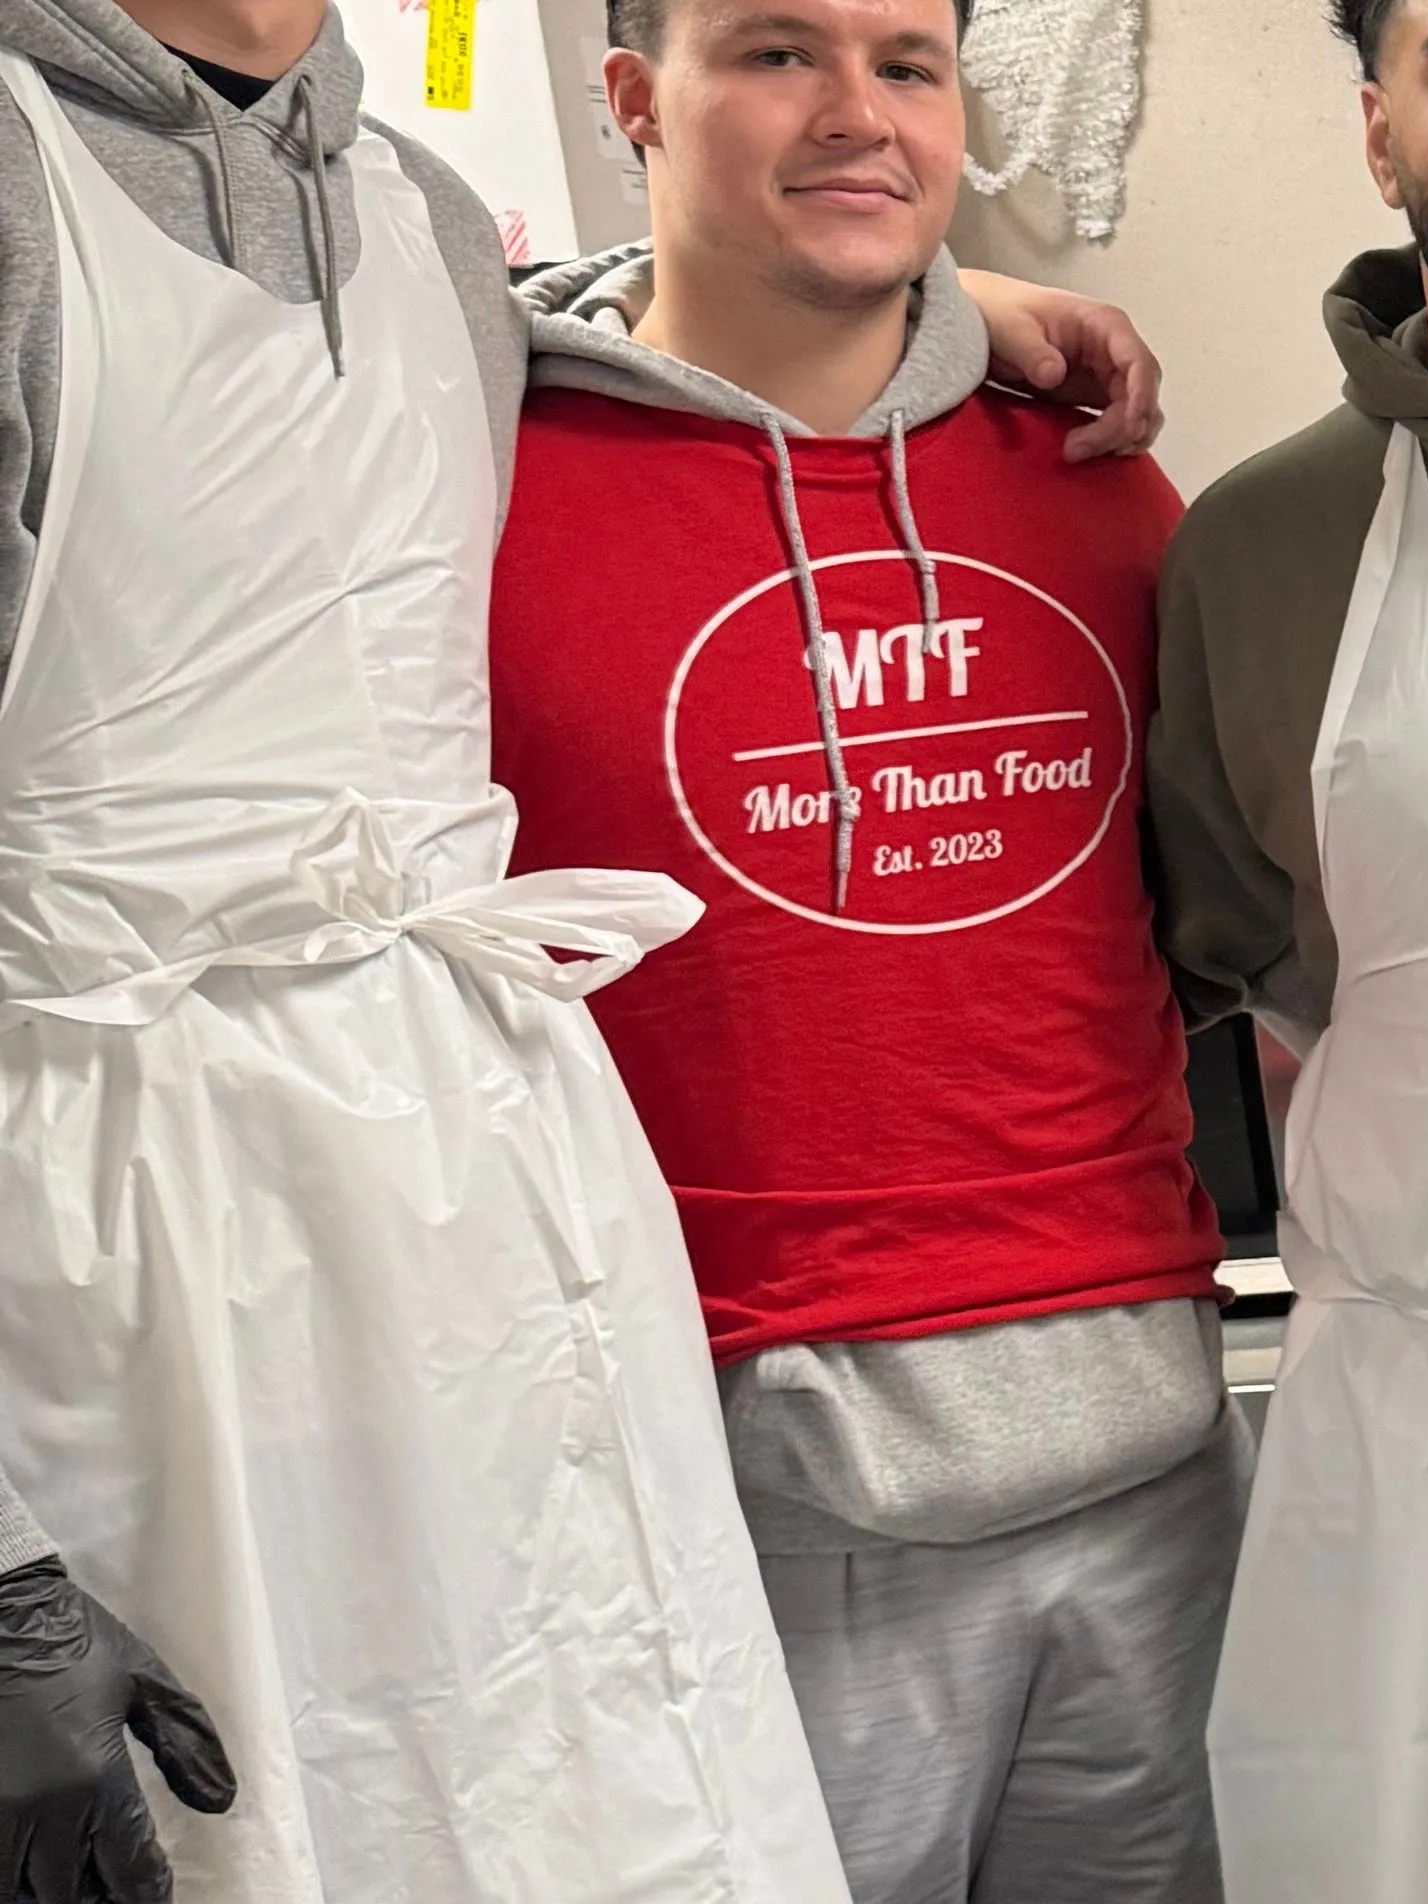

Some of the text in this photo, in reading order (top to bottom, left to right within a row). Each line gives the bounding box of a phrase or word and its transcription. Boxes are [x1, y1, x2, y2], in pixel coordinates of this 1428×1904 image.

[803, 617, 984, 710] MTF
[871, 765, 987, 813] Than
[994, 747, 1093, 797] Food
[873, 829, 1004, 877] Est. 2023
